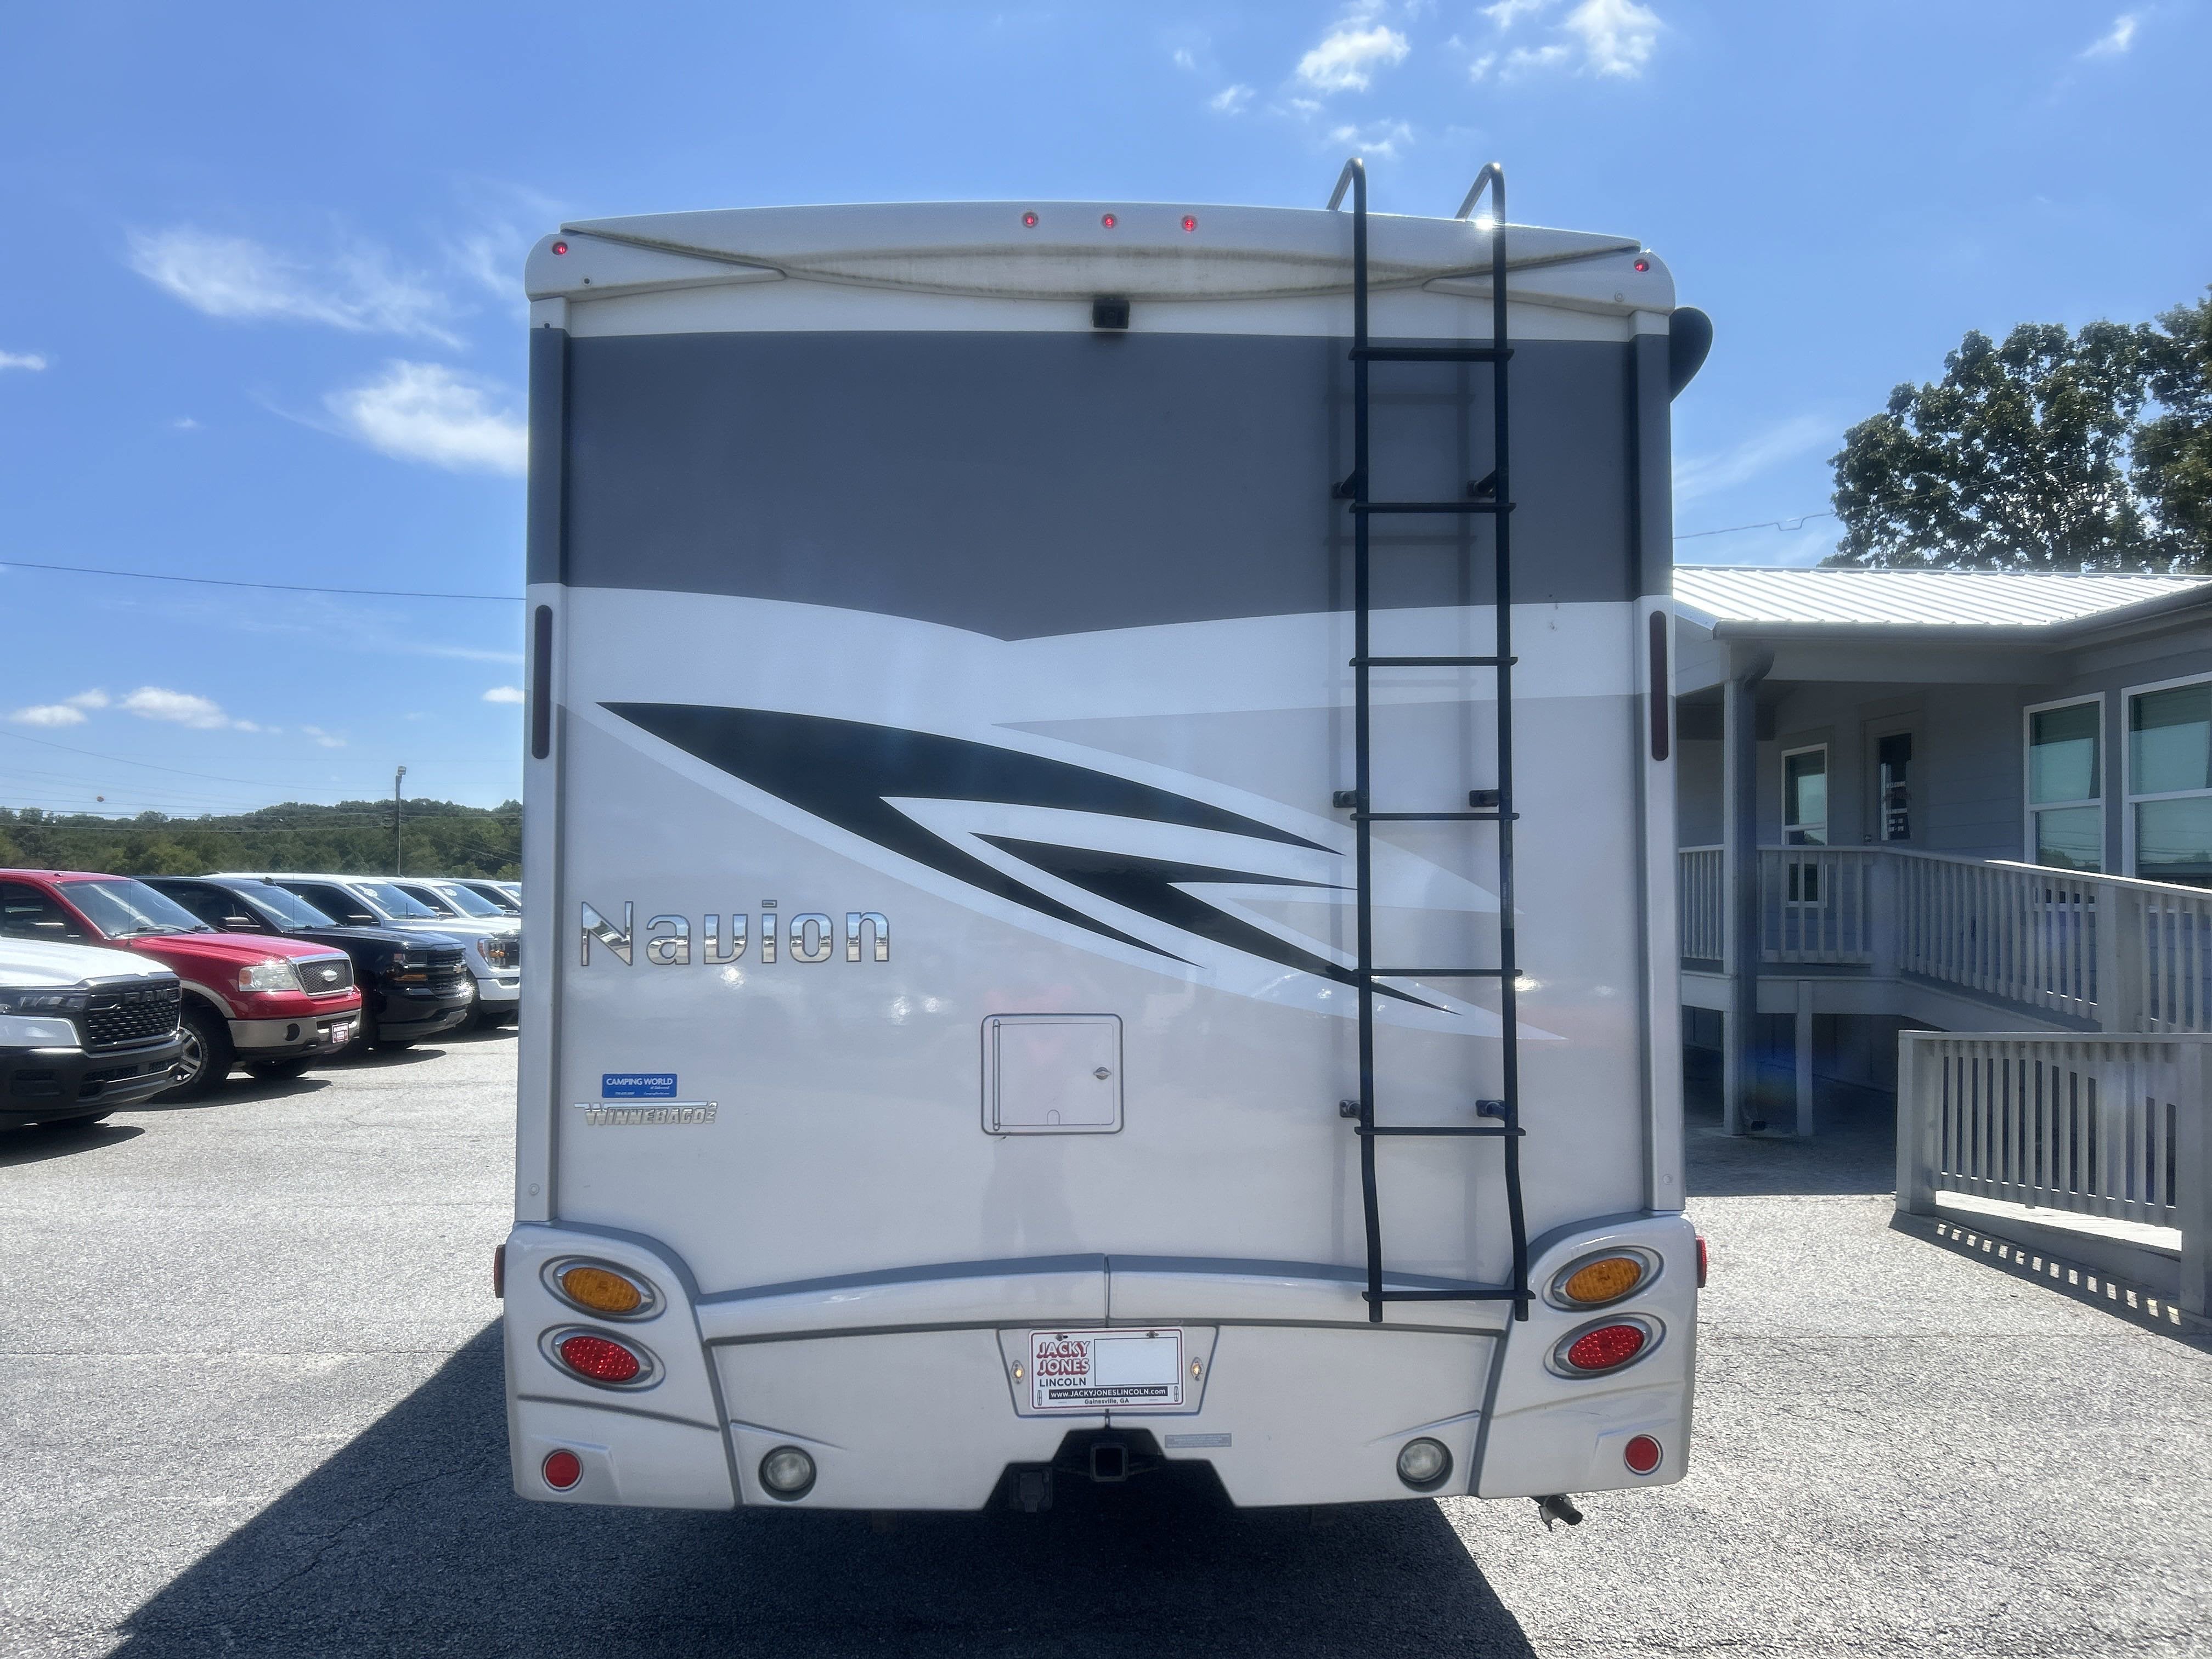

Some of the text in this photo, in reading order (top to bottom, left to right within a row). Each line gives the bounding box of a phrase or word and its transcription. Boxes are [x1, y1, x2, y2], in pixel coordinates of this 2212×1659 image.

[580, 899, 890, 967] Navion
[123, 989, 168, 1004] RAM
[574, 1101, 708, 1125] WINNEBAGO
[1036, 1341, 1091, 1358] JACKY
[1037, 1358, 1090, 1376] JONES
[1040, 1378, 1086, 1387] LINCOLN
[1051, 1389, 1166, 1398] www.JACKYJONESLINCOLN.com
